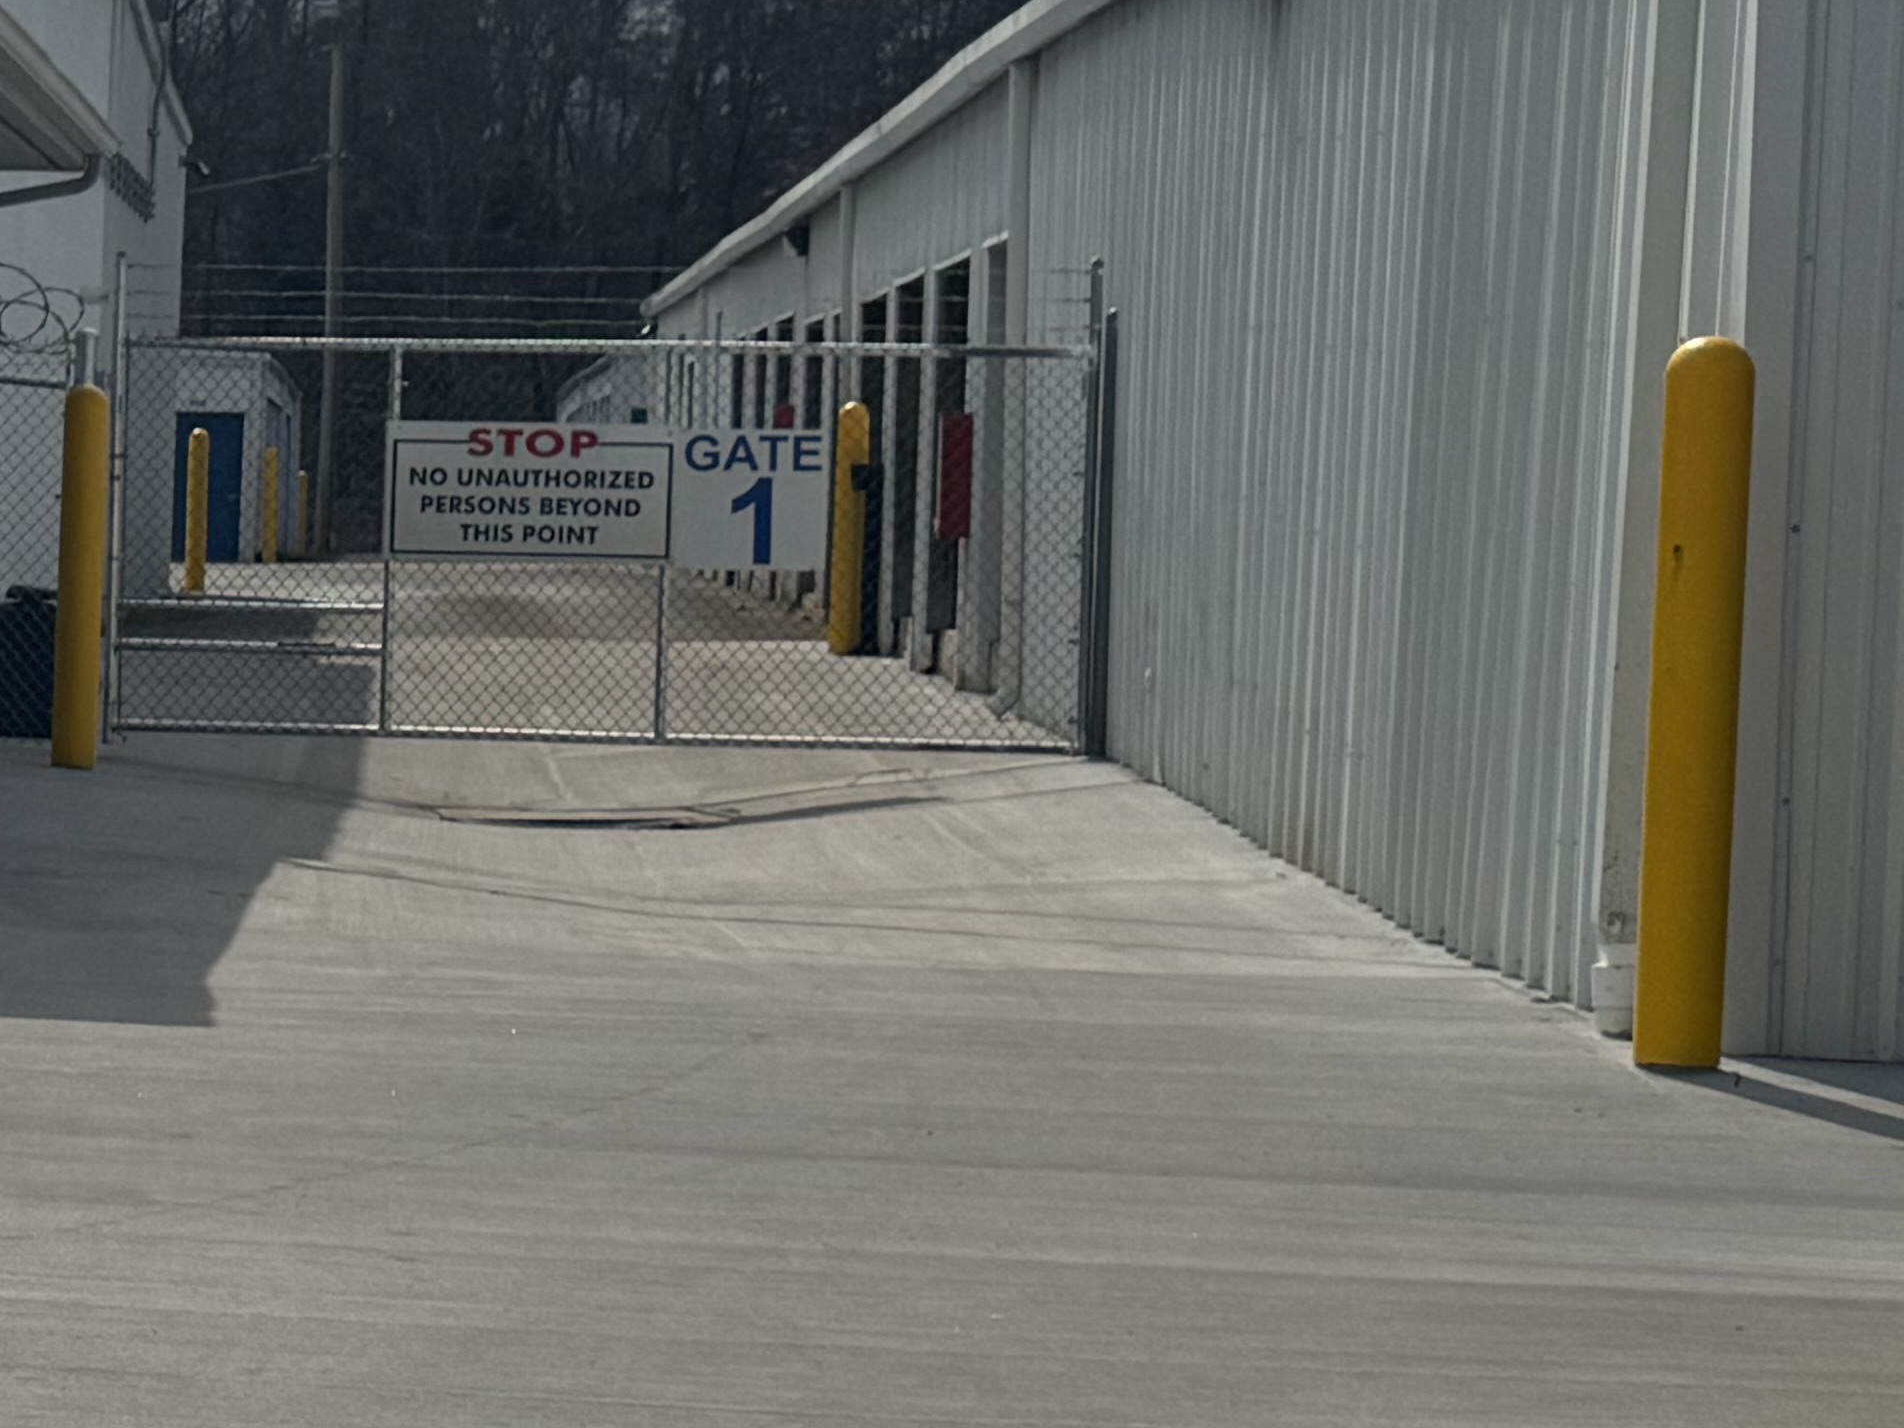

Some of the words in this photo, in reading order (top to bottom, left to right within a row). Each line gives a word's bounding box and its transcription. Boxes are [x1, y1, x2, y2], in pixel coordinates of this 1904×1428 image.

[467, 428, 599, 458] STOP
[684, 434, 823, 472] GATE
[409, 467, 448, 487] NO
[457, 468, 655, 490] UNAUTHORIZED
[419, 495, 531, 516] PERSONS
[538, 497, 642, 517] BEYOND
[730, 477, 773, 565] 1
[460, 524, 514, 543] THIS
[521, 525, 599, 545] POINT
